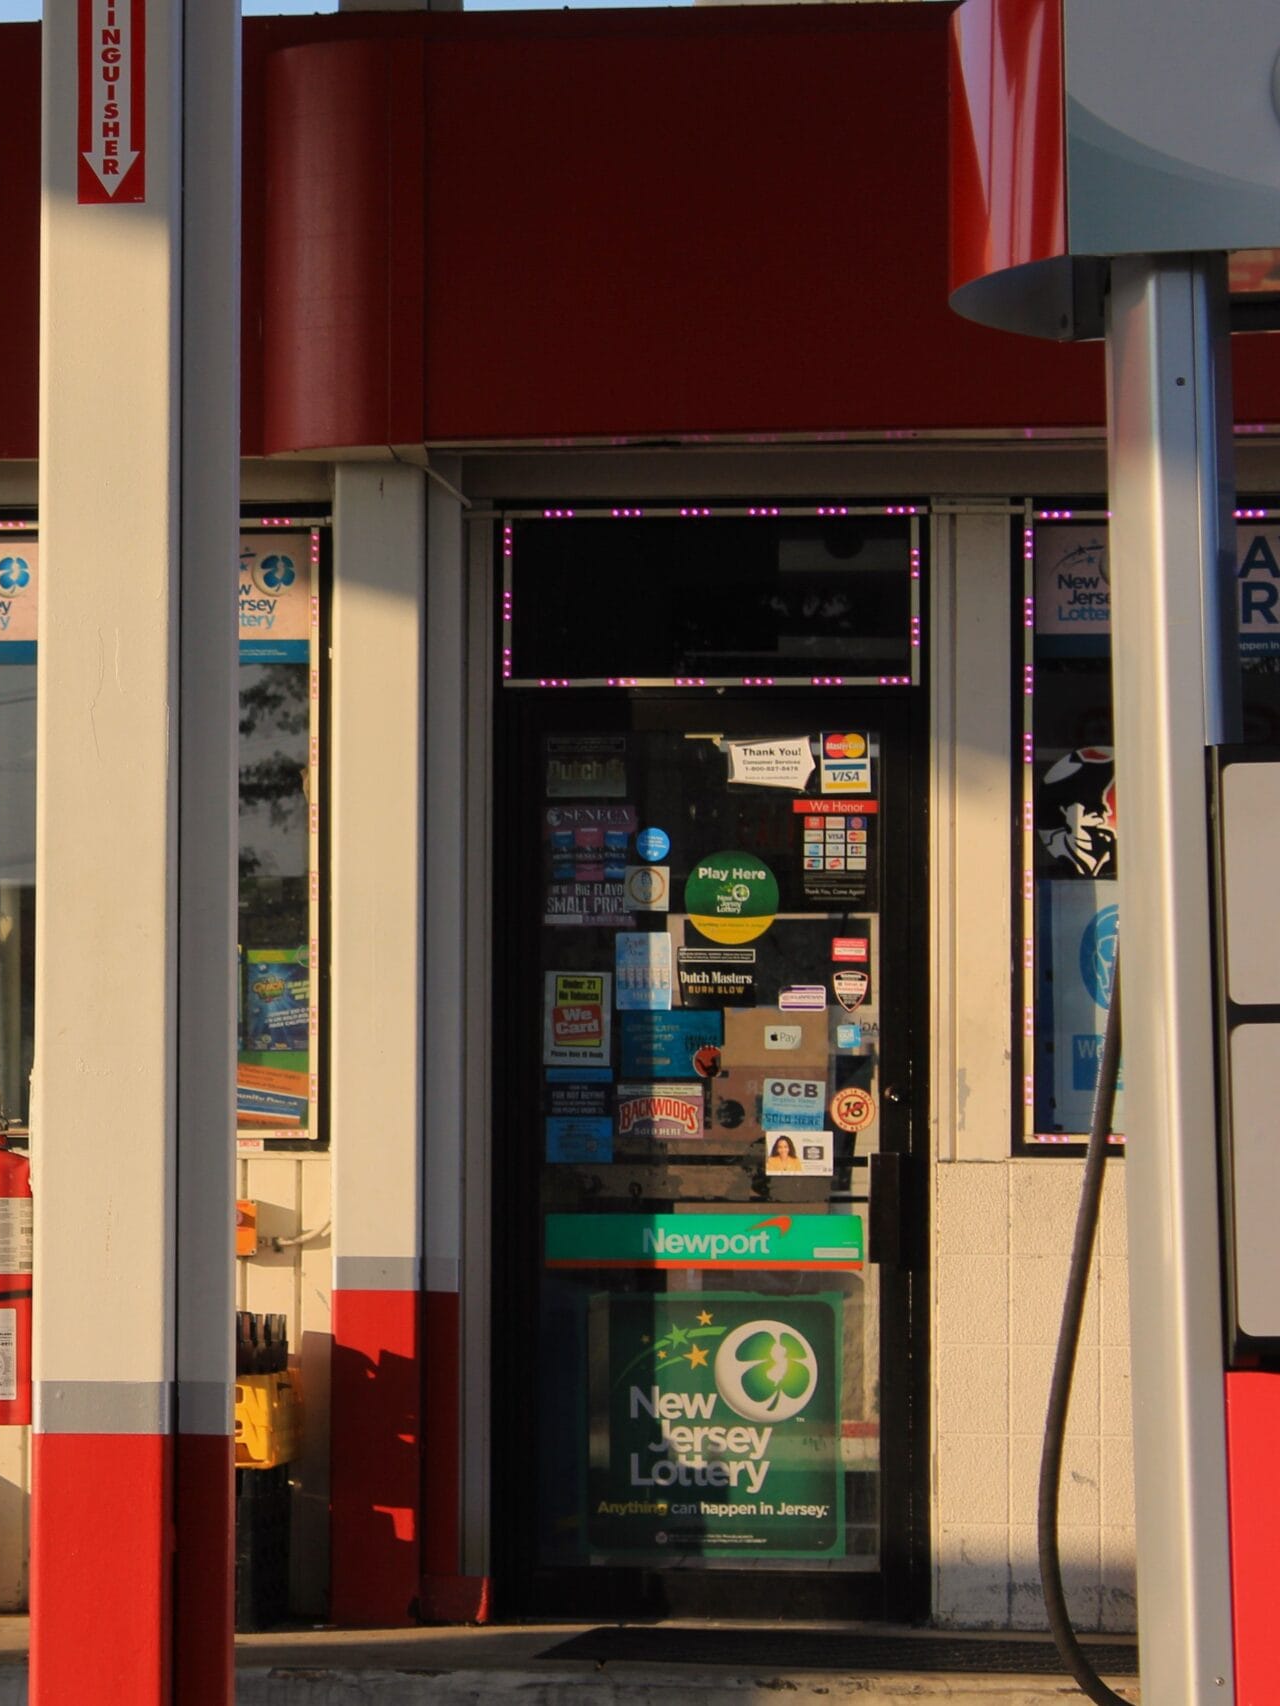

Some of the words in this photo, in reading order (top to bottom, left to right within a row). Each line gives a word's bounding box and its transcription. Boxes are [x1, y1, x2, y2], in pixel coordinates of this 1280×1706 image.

[1057, 573, 1100, 590] New
[1067, 589, 1109, 606] Jers
[239, 599, 277, 614] rsey
[1057, 605, 1109, 622] Lotte
[239, 613, 275, 629] tery
[743, 748, 774, 756] Thank
[779, 747, 802, 756] You!
[831, 771, 860, 782] VISA
[810, 801, 829, 812] We
[833, 801, 865, 812] Honor
[698, 867, 729, 881] Play
[732, 868, 766, 880] Here
[594, 882, 625, 896] FLAVO
[547, 896, 589, 913] SMALL
[680, 970, 709, 984] Dutch
[712, 970, 753, 984] Masters
[688, 985, 714, 994] BURN
[562, 1008, 592, 1020] We
[556, 1020, 599, 1034] Card
[780, 1031, 797, 1045] Pay
[771, 1082, 819, 1098] OCB
[620, 1097, 697, 1131] BACKWOODS
[844, 1101, 864, 1117] 18
[643, 1228, 770, 1259] Newport
[630, 1385, 717, 1419] New
[647, 1418, 773, 1460] Jersey
[630, 1452, 770, 1494] Lottery
[598, 1501, 668, 1516] Anything
[671, 1503, 697, 1515] can
[701, 1502, 754, 1516] happen
[760, 1502, 774, 1515] in
[777, 1503, 827, 1518] Jersey.
